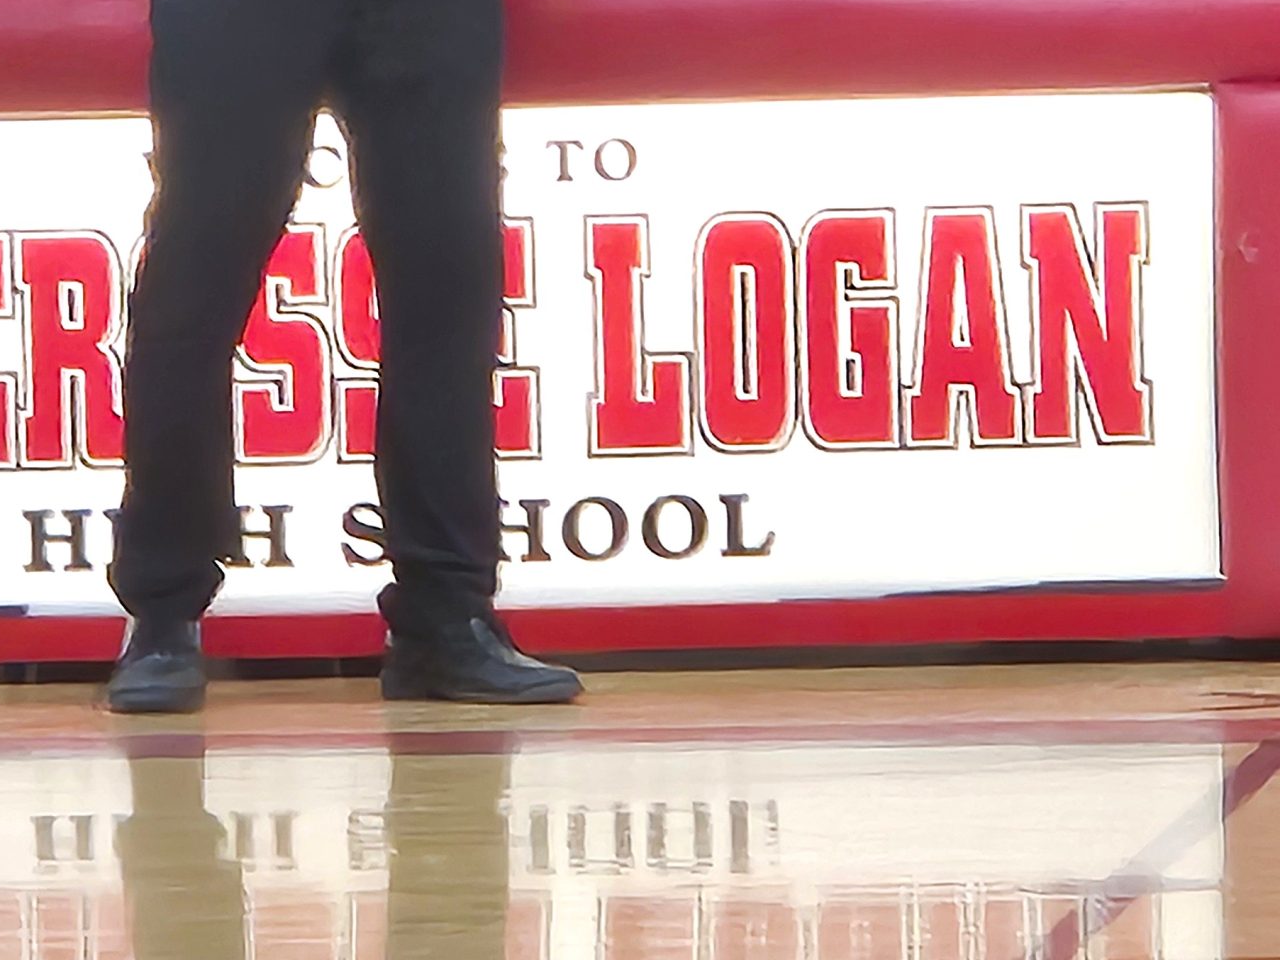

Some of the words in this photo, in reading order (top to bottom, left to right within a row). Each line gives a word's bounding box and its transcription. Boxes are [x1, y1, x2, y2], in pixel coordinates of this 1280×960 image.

[546, 139, 638, 183] TO
[584, 200, 1156, 459] LOGAN
[23, 504, 295, 572] HH
[342, 493, 776, 570] SHOOL
